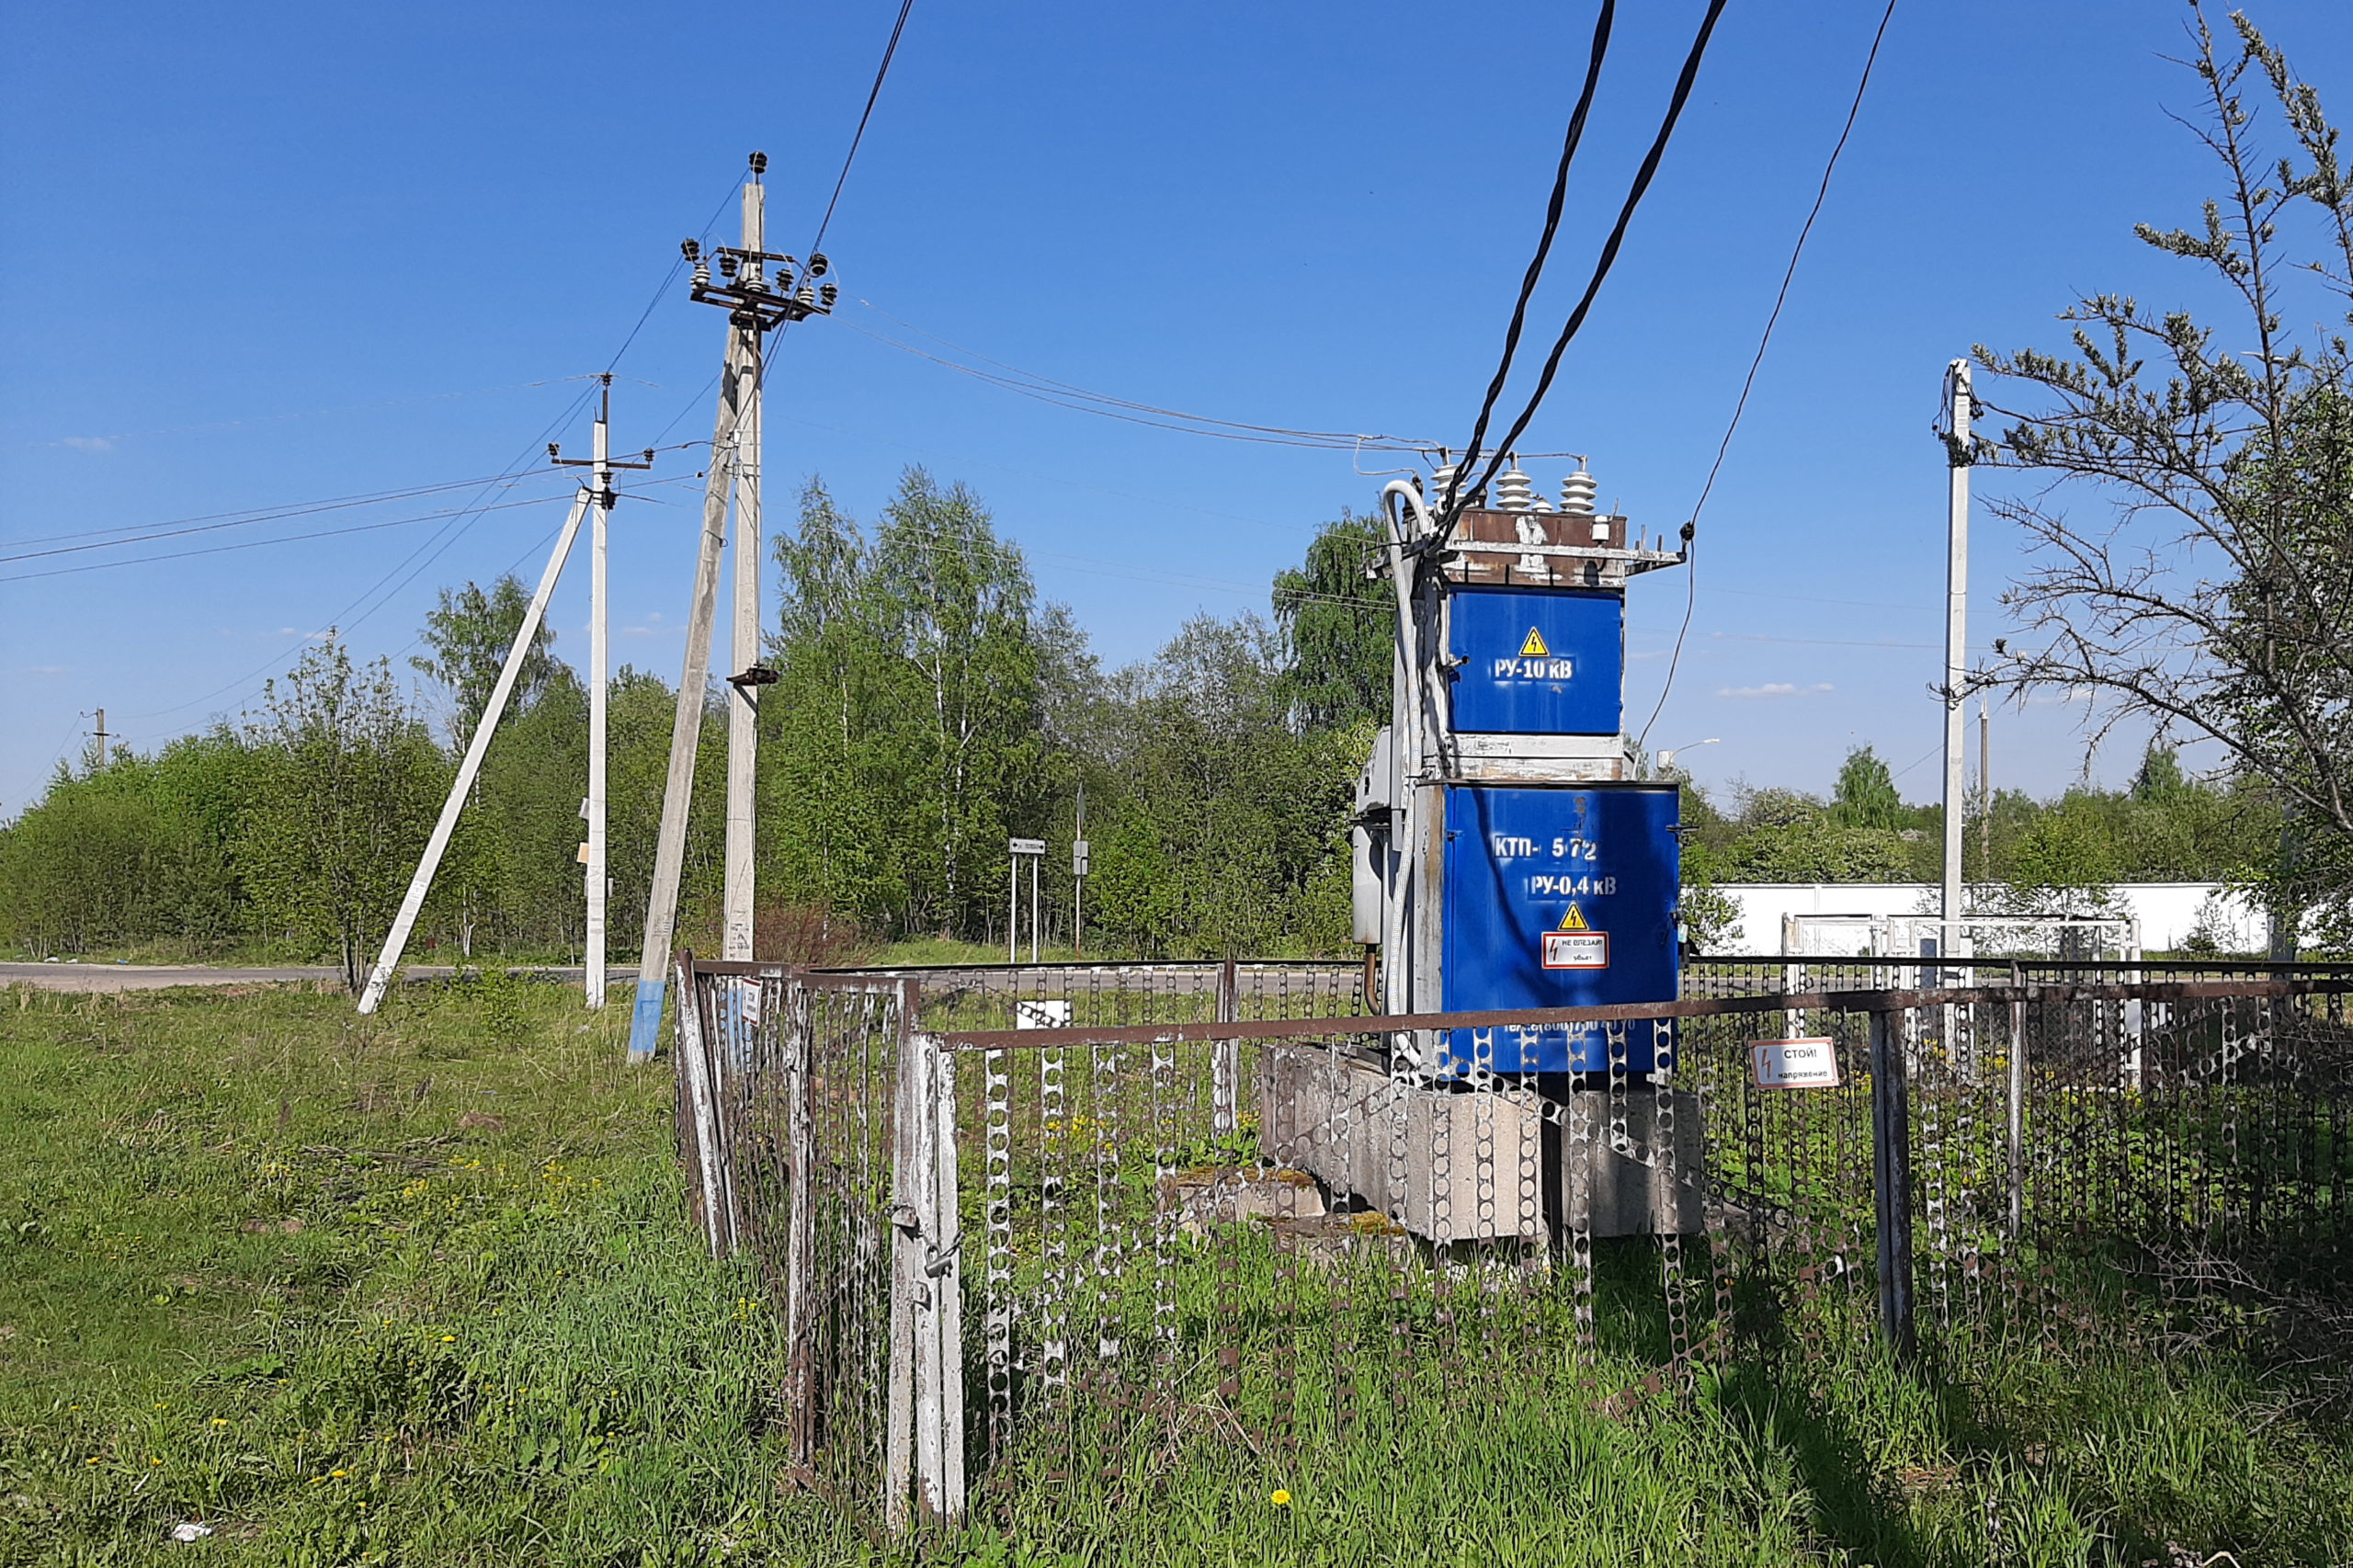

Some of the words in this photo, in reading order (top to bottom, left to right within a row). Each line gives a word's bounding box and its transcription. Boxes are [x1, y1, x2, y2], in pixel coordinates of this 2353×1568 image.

[1495, 658, 1545, 678] РУ-10
[1549, 660, 1573, 679] кВ
[1552, 837, 1597, 860] 572
[1531, 876, 1589, 896] РУ-0,4
[1593, 876, 1617, 895] кВ
[1784, 1047, 1817, 1059] СТОЙ!
